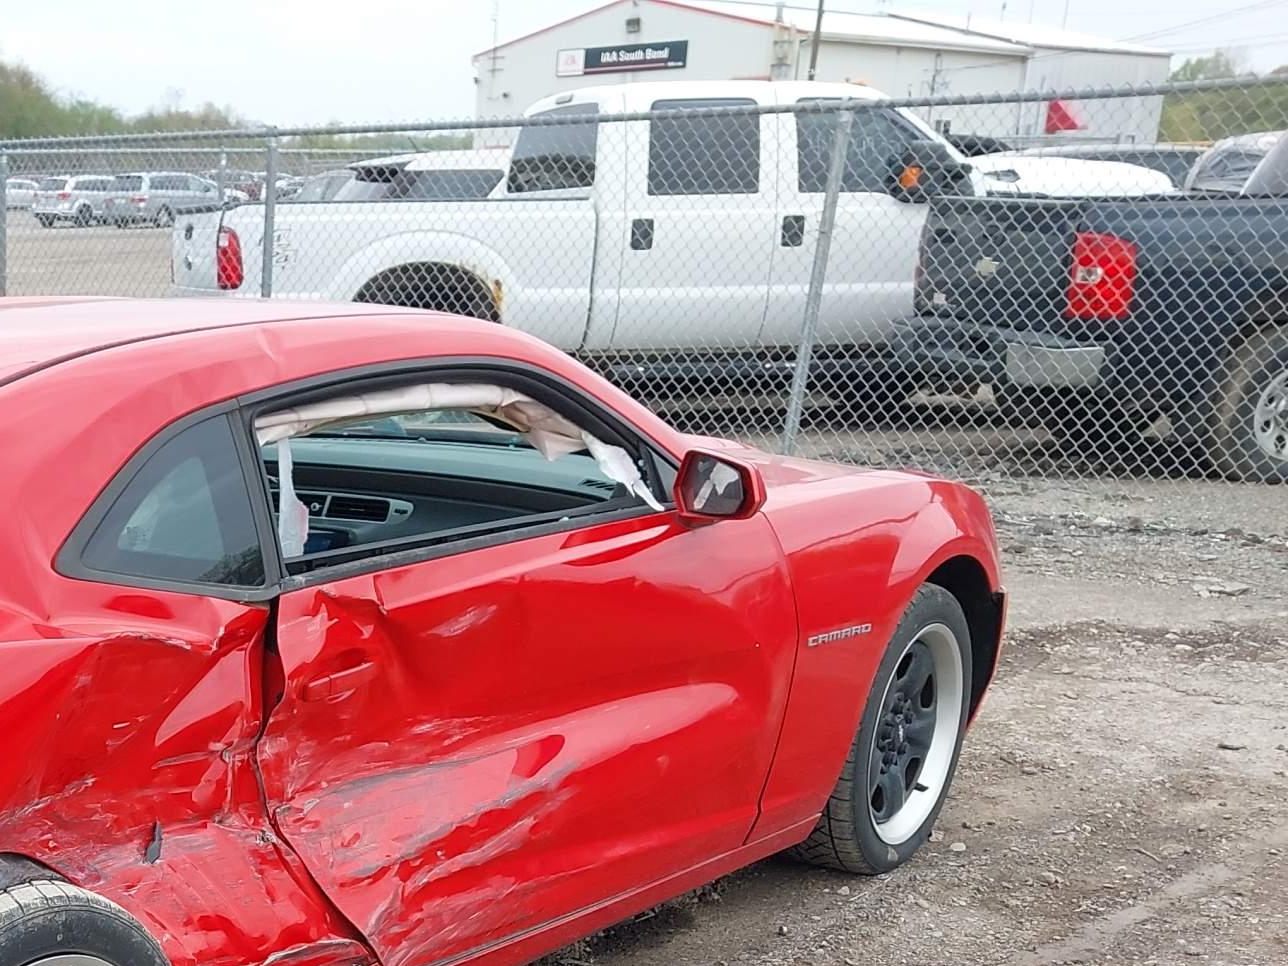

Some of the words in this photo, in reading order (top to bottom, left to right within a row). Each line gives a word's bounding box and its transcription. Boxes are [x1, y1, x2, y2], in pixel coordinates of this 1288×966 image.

[618, 49, 643, 62] South
[645, 47, 670, 60] Bend
[807, 623, 873, 647] CAMARO
